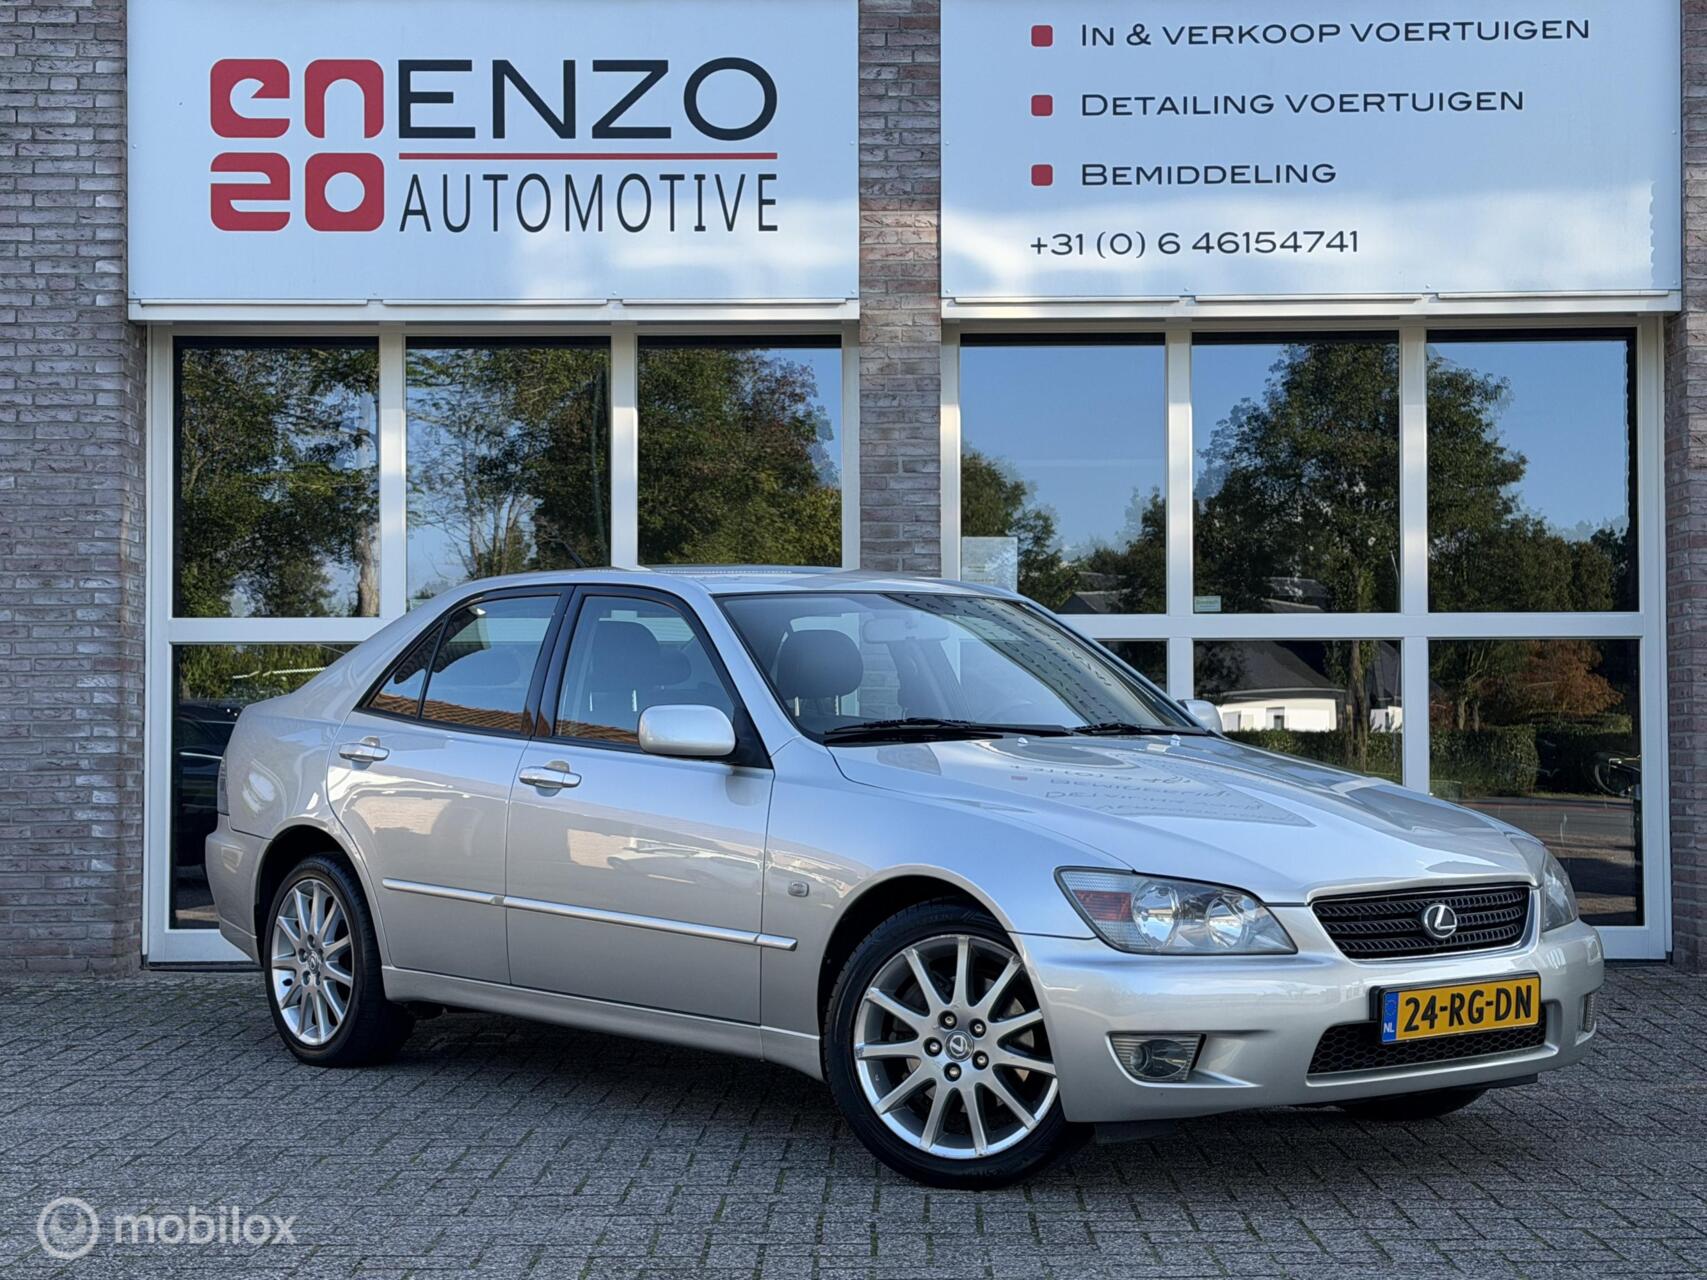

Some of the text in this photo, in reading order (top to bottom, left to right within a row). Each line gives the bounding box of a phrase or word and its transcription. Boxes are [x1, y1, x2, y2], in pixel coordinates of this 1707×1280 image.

[1125, 23, 1152, 46] &
[1162, 22, 1342, 46] VERKOOP
[1350, 19, 1591, 43] VOERTUIGEN
[398, 57, 778, 141] ENZO
[1080, 91, 1524, 117] DETAILING VOERTUIGEN
[1081, 163, 1337, 187] BEMIDDELING
[399, 173, 778, 232] AUTOMOTIVE
[1030, 233, 1084, 256] +31
[1158, 233, 1181, 255] 6
[1191, 230, 1359, 254] 46154741
[1383, 985, 1532, 1033] NL 24-RG-DN
